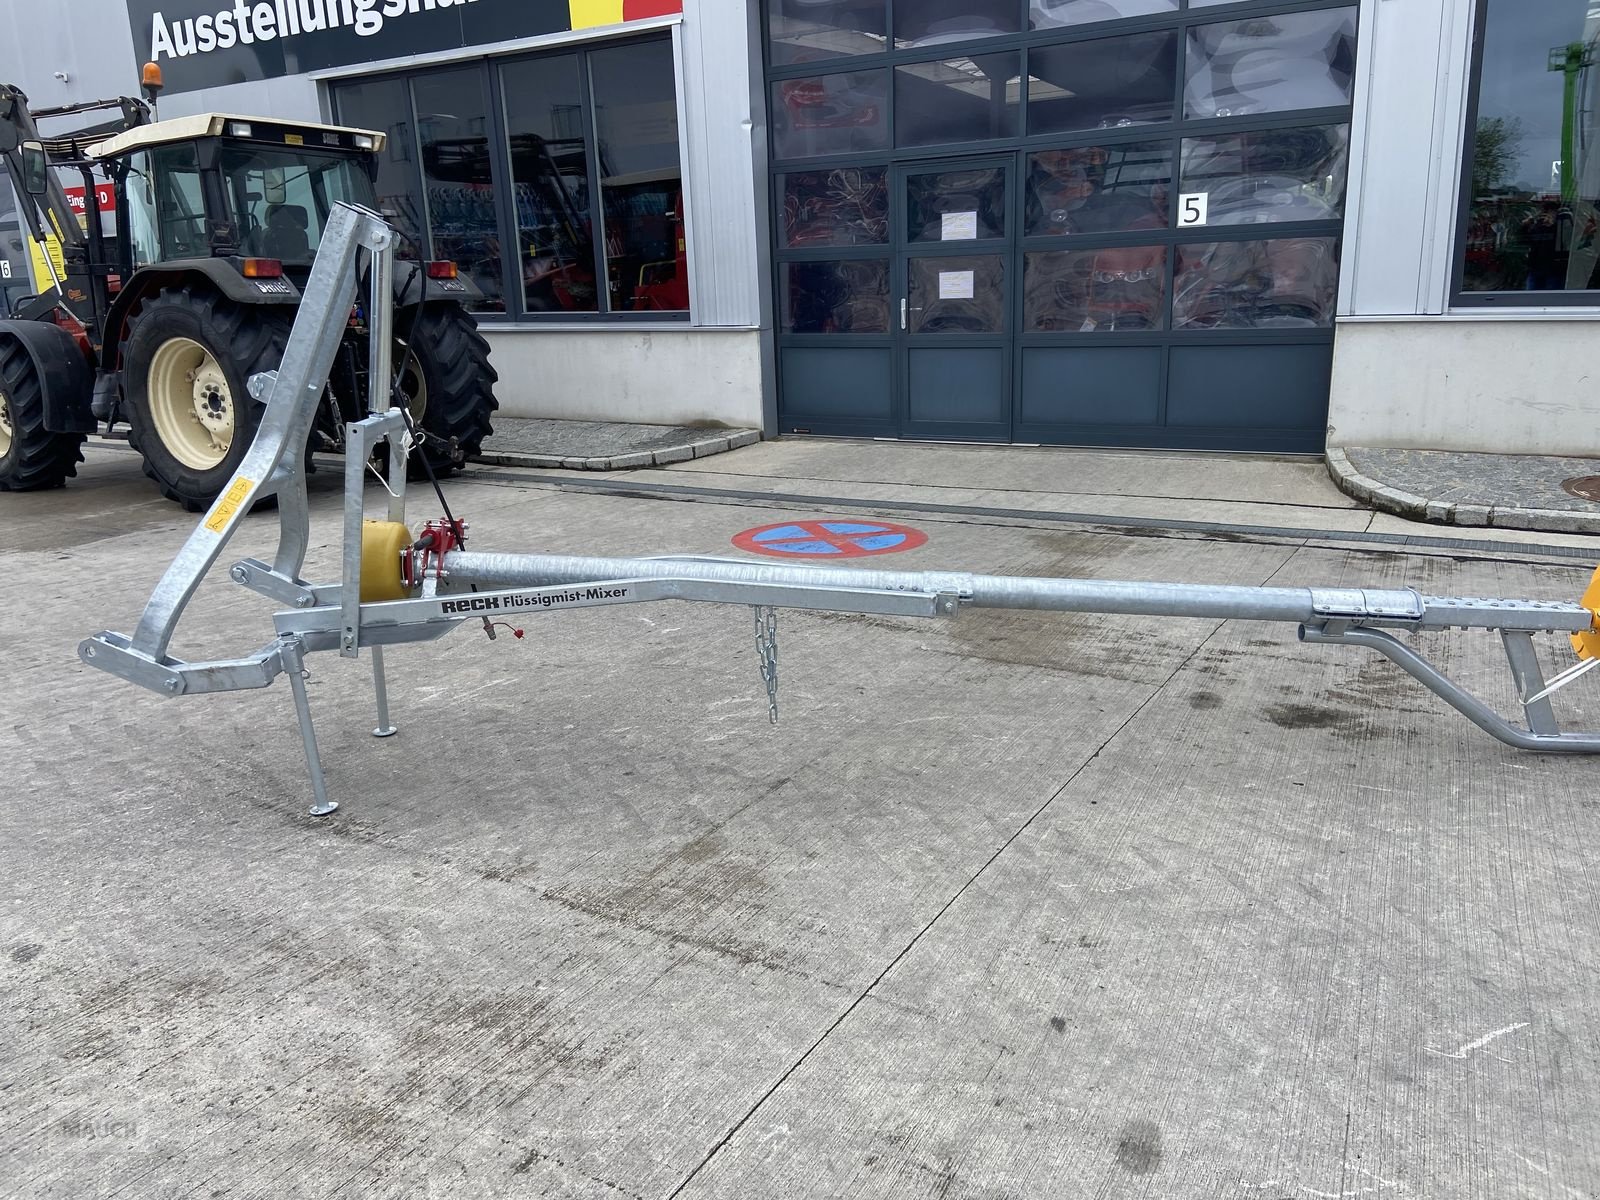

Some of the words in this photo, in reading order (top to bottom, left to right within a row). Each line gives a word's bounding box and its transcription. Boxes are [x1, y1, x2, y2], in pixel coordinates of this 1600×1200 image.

[100, 191, 108, 204] D
[1183, 197, 1200, 223] 5
[2, 262, 9, 276] 6
[503, 587, 628, 608] Flüssigmist-Mixer
